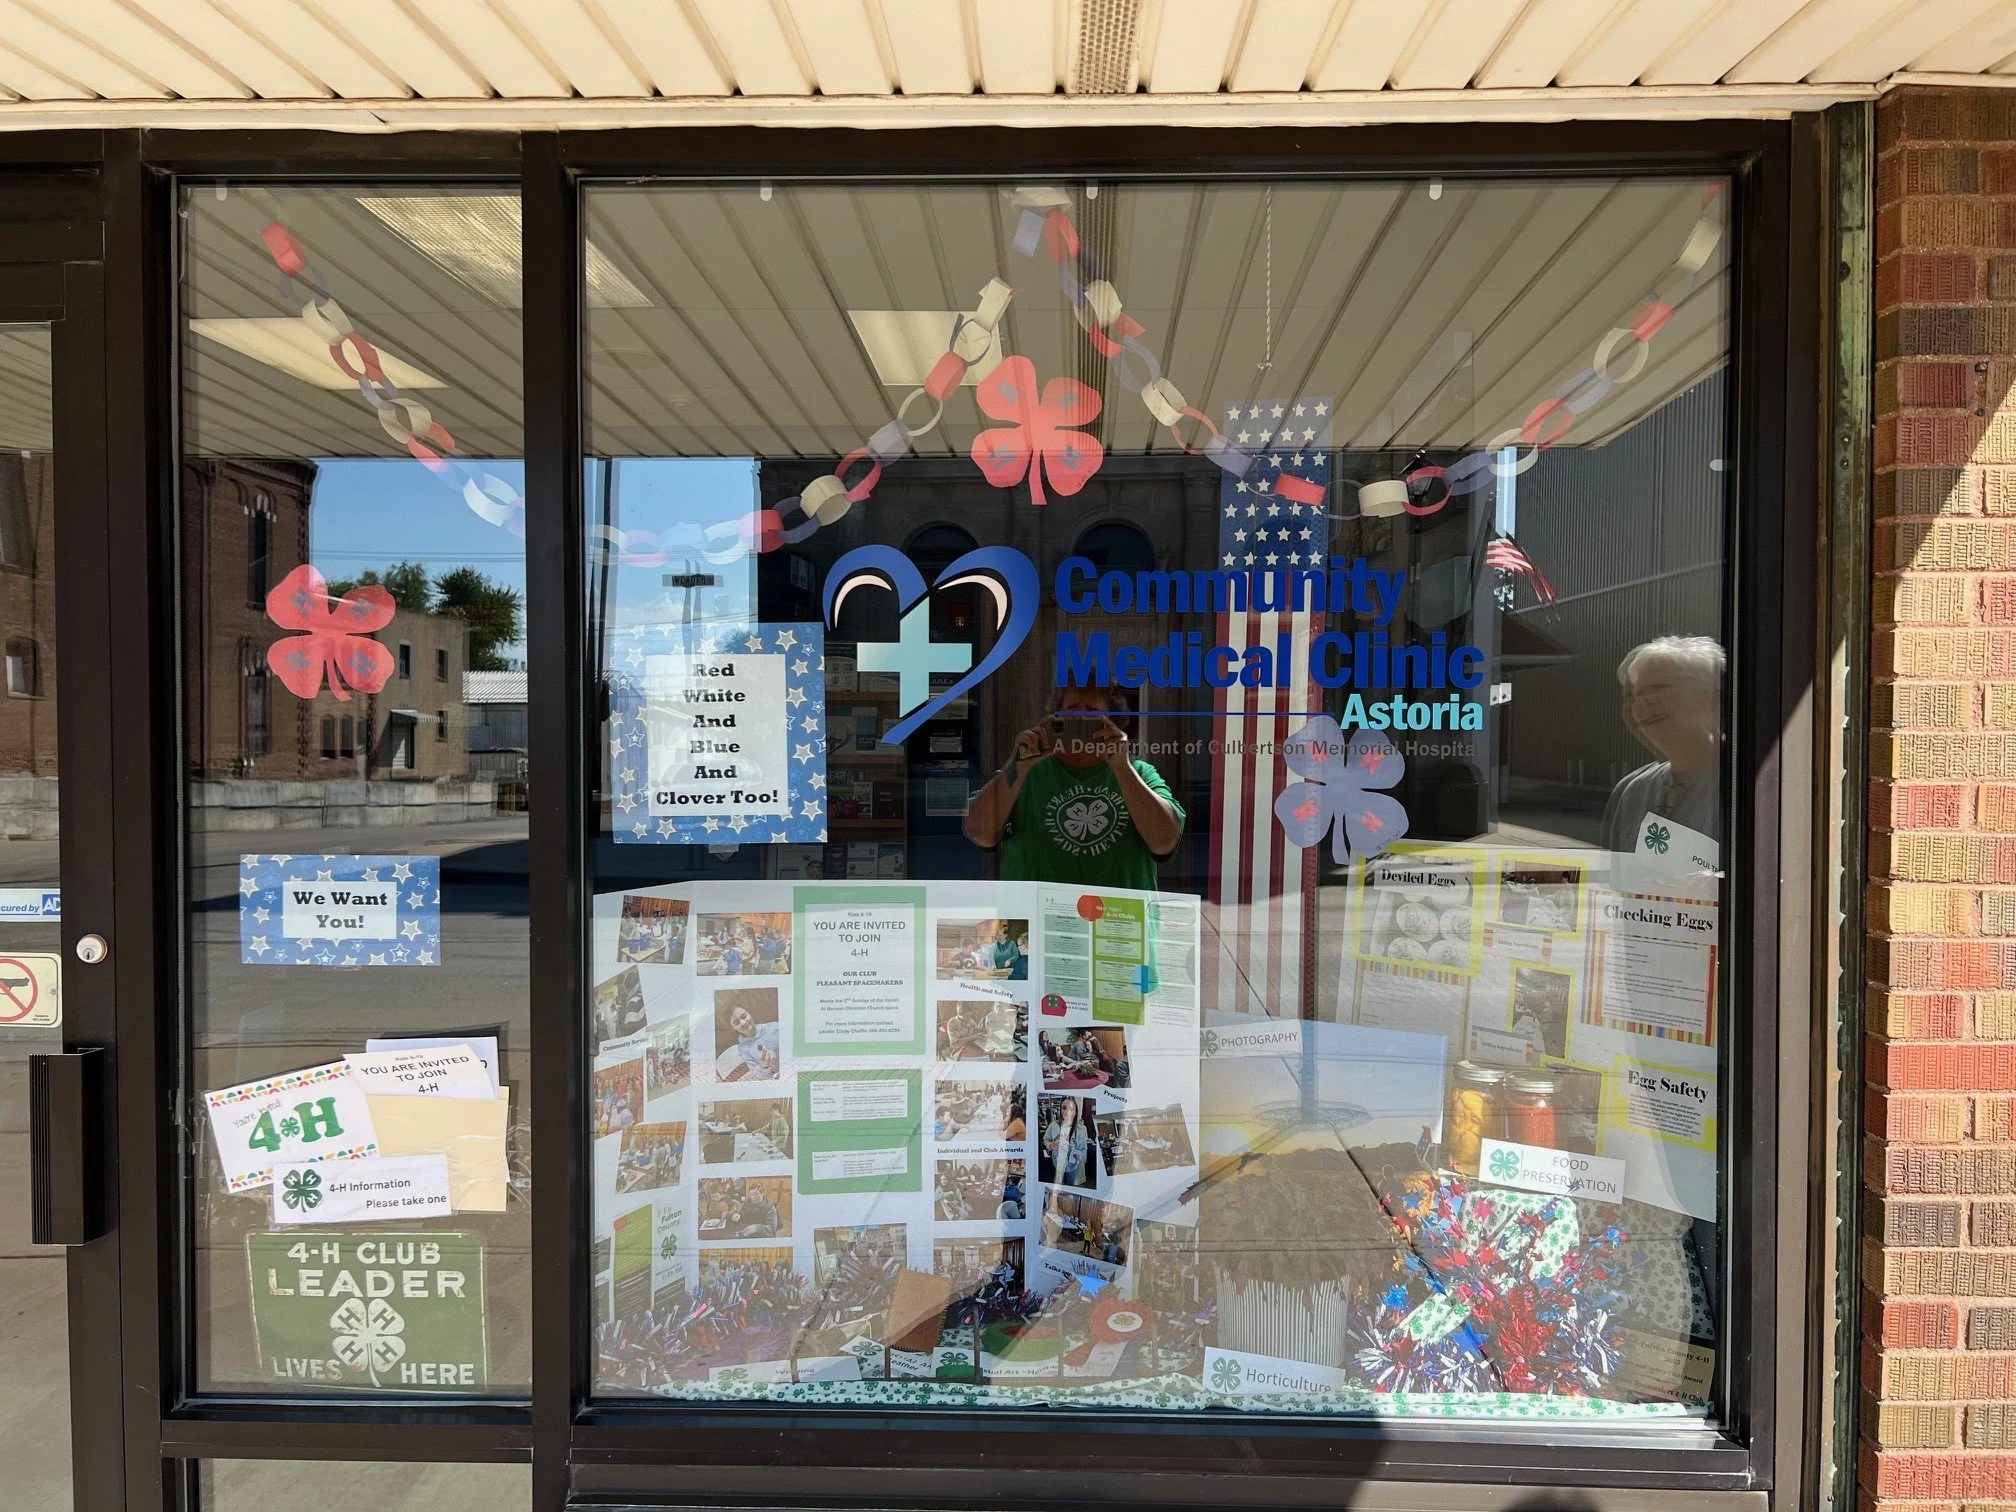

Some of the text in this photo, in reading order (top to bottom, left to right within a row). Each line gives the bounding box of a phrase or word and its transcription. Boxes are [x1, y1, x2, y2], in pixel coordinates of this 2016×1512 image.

[1055, 556, 1406, 626] Community
[1055, 631, 1484, 689] Medical Clinic
[692, 663, 735, 677] Red
[682, 689, 746, 703] White
[1340, 693, 1484, 730] Astoria
[692, 714, 737, 728] And
[690, 740, 741, 754] Blue
[1053, 738, 1478, 760] A Department of Culbertson Memorial Hospital
[694, 765, 738, 779] And
[656, 789, 779, 805] Clover Too!
[1381, 868, 1456, 889] Deviled Eggs
[293, 891, 388, 906] We Want
[29, 904, 40, 914] by
[316, 914, 365, 929] You!
[813, 921, 906, 931] YOU ARE INVITED
[1603, 904, 1714, 933] Checking Eggs
[838, 934, 881, 943] TO JOIN
[850, 948, 869, 957] 4-H
[1221, 1032, 1298, 1048] PHOTOGRAPHY
[361, 1055, 471, 1076] YOU ARE INVITED
[395, 1068, 448, 1082] TO JOIN
[418, 1083, 440, 1095] 4-H
[1628, 1069, 1710, 1103] Egg Safety
[1553, 1156, 1589, 1171] FOOD
[329, 1178, 411, 1193] 4-H Information
[1522, 1169, 1617, 1193] PRESERVATION
[366, 1194, 447, 1209] Please take one
[287, 1241, 441, 1265] 4-H CLUB
[268, 1268, 466, 1298] LEADER
[271, 1356, 475, 1385] LIVES HERE
[891, 1360, 919, 1372] eather
[1246, 1368, 1332, 1392] Horticulture
[1683, 1374, 1704, 1384] Award
